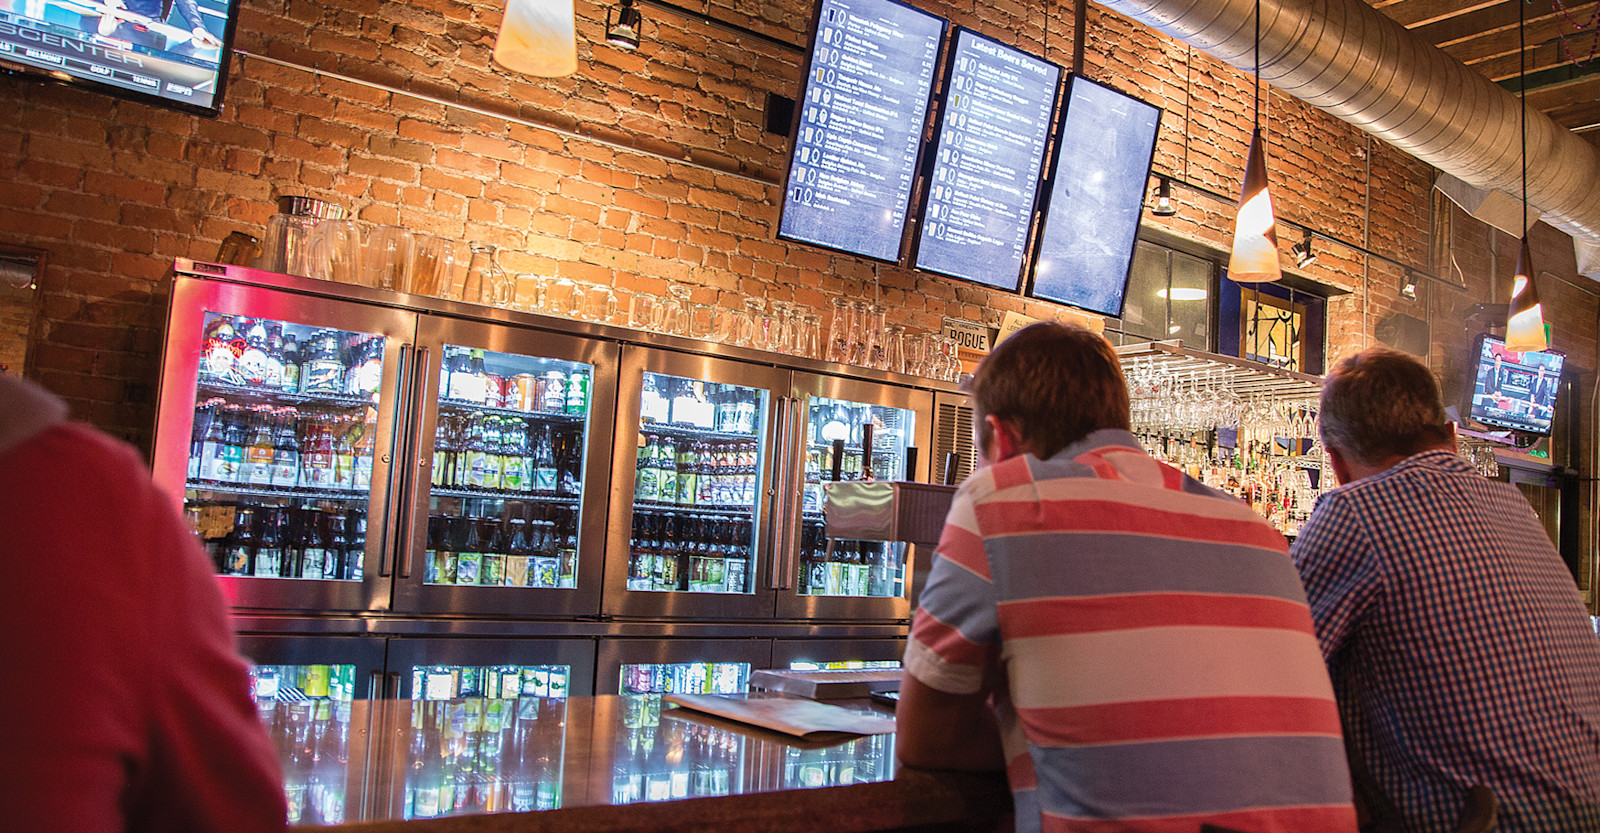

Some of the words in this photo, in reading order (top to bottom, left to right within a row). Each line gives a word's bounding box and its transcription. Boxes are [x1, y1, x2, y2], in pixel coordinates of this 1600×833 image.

[971, 39, 996, 56] Latest
[997, 49, 1020, 65] Beers
[1021, 59, 1047, 75] Served
[90, 64, 110, 75] GOLF
[951, 330, 986, 351] ROGUE
